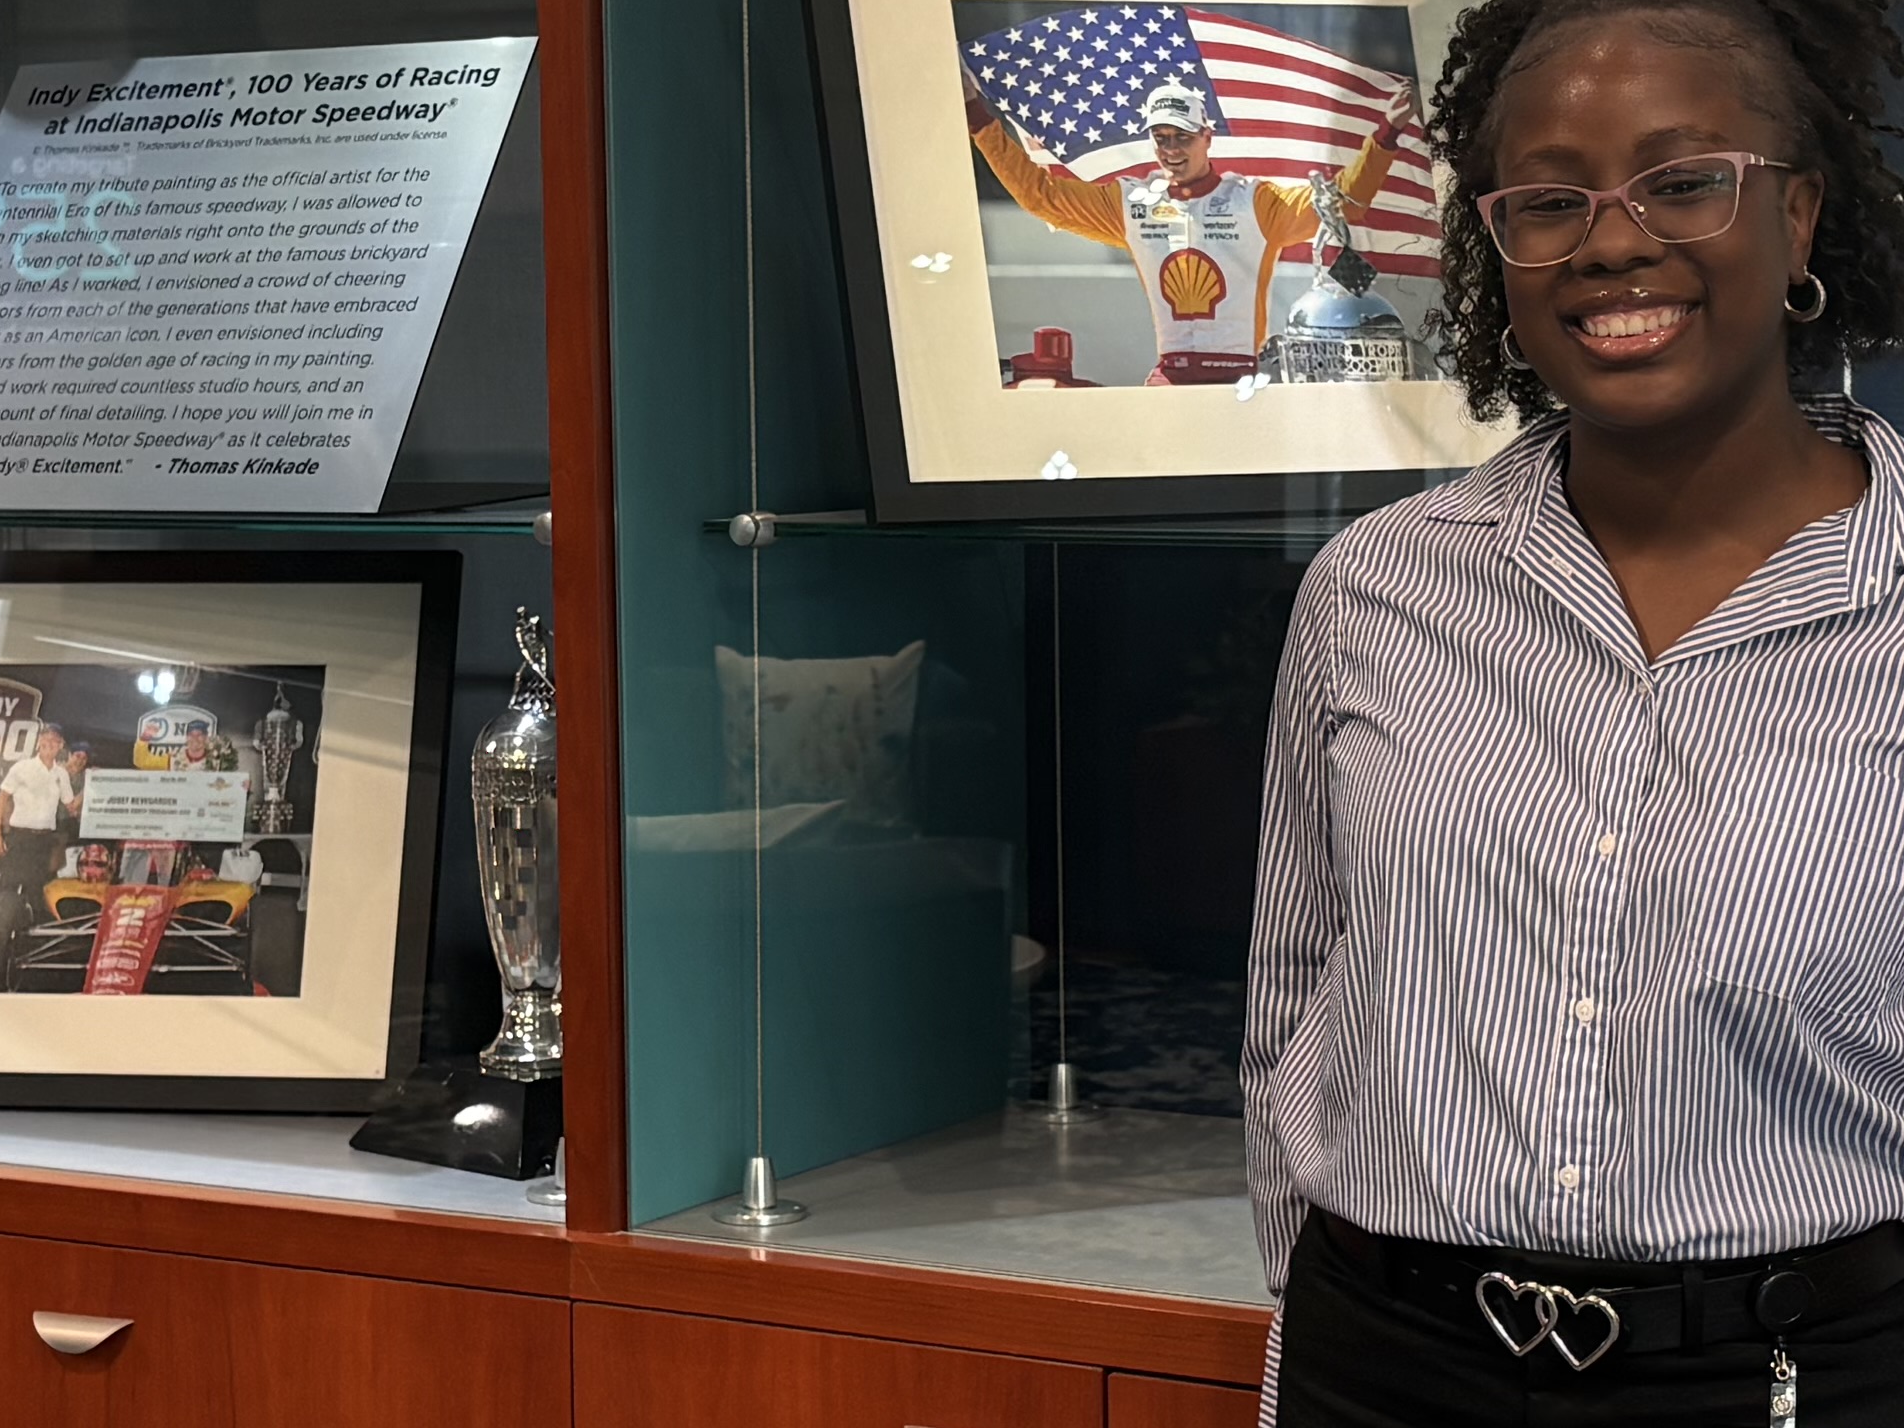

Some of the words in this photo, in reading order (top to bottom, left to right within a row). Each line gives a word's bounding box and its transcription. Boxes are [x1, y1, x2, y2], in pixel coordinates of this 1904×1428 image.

[28, 85, 80, 108] Indy
[247, 74, 292, 95] 100
[303, 68, 367, 92] Years
[376, 66, 404, 89] of
[411, 64, 500, 88] Racing
[44, 116, 71, 136] at
[76, 108, 222, 134] Indianapolis
[230, 103, 306, 127] Motor
[137, 140, 189, 151] Trademarks
[193, 139, 205, 149] of
[354, 132, 378, 142] used
[380, 132, 409, 141] under
[20, 183, 67, 195] create
[70, 182, 96, 196] my
[99, 178, 148, 193] tribute
[152, 175, 217, 193] painting
[220, 176, 237, 189] as
[243, 174, 268, 187] the
[272, 170, 326, 186] official
[329, 170, 371, 184] artist
[376, 168, 400, 183] for
[403, 167, 430, 182] the
[65, 205, 87, 218] Era
[94, 202, 112, 217] of
[114, 202, 141, 217] this
[145, 200, 202, 215] famous
[206, 198, 286, 215] speedway,
[292, 197, 298, 211] I
[303, 198, 332, 210] was
[337, 194, 402, 209] allowed
[405, 194, 422, 207] to
[8, 231, 33, 246] my
[36, 227, 107, 245] sketching
[113, 225, 180, 241] materials
[186, 223, 223, 242] right
[227, 223, 263, 238] onto
[269, 222, 294, 236] the
[298, 220, 365, 238] grounds
[370, 219, 390, 234] of
[392, 219, 418, 233] the
[17, 255, 53, 268] even
[56, 254, 83, 270] got
[87, 253, 103, 267] to
[105, 252, 130, 267] set
[135, 252, 154, 268] up
[158, 250, 187, 265] and
[193, 249, 231, 264] work
[236, 249, 250, 263] at
[257, 247, 281, 262] the
[286, 246, 345, 262] famous
[350, 244, 429, 262] brickyard
[48, 278, 69, 293] As
[83, 276, 142, 292] worked,
[155, 273, 240, 290] envisioned
[244, 276, 253, 288] a
[258, 272, 309, 287] crowd
[313, 272, 331, 287] of
[335, 271, 406, 288] cheering
[26, 303, 62, 319] from
[66, 302, 103, 317] each
[107, 300, 126, 316] of
[128, 300, 153, 315] the
[156, 297, 249, 318] generations
[255, 300, 287, 313] that
[291, 299, 329, 313] have
[334, 296, 419, 314] embraced
[4, 331, 21, 343] as
[25, 331, 43, 342] an
[48, 327, 121, 343] American
[125, 326, 161, 342] icon.
[175, 328, 212, 341] even
[217, 325, 305, 340] envisioned
[308, 324, 383, 341] including
[19, 353, 55, 369] from
[59, 354, 84, 368] the
[88, 352, 142, 371] golden
[146, 354, 175, 370] age
[180, 352, 200, 367] of
[200, 352, 251, 370] racing
[254, 351, 269, 366] in
[274, 354, 299, 370] my
[303, 351, 374, 369] painting.
[11, 380, 47, 394] work
[52, 378, 117, 397] required
[121, 379, 195, 394] countless
[199, 378, 249, 393] studio
[253, 378, 302, 395] hours,
[308, 378, 341, 393] and
[343, 380, 364, 393] an
[39, 405, 59, 421] of
[62, 404, 93, 420] final
[96, 404, 166, 423] detailing.
[172, 405, 178, 420] I
[182, 405, 222, 423] hope
[225, 407, 256, 423] you
[263, 404, 291, 420] will
[291, 405, 323, 423] join
[327, 407, 353, 420] me
[359, 404, 373, 420] in
[83, 431, 130, 447] Motor
[227, 434, 245, 448] as
[250, 432, 262, 447] it
[266, 432, 351, 448] celebrates
[32, 458, 133, 474] Excitement."
[168, 458, 239, 475] Thomas
[242, 457, 320, 475] Kinkade
